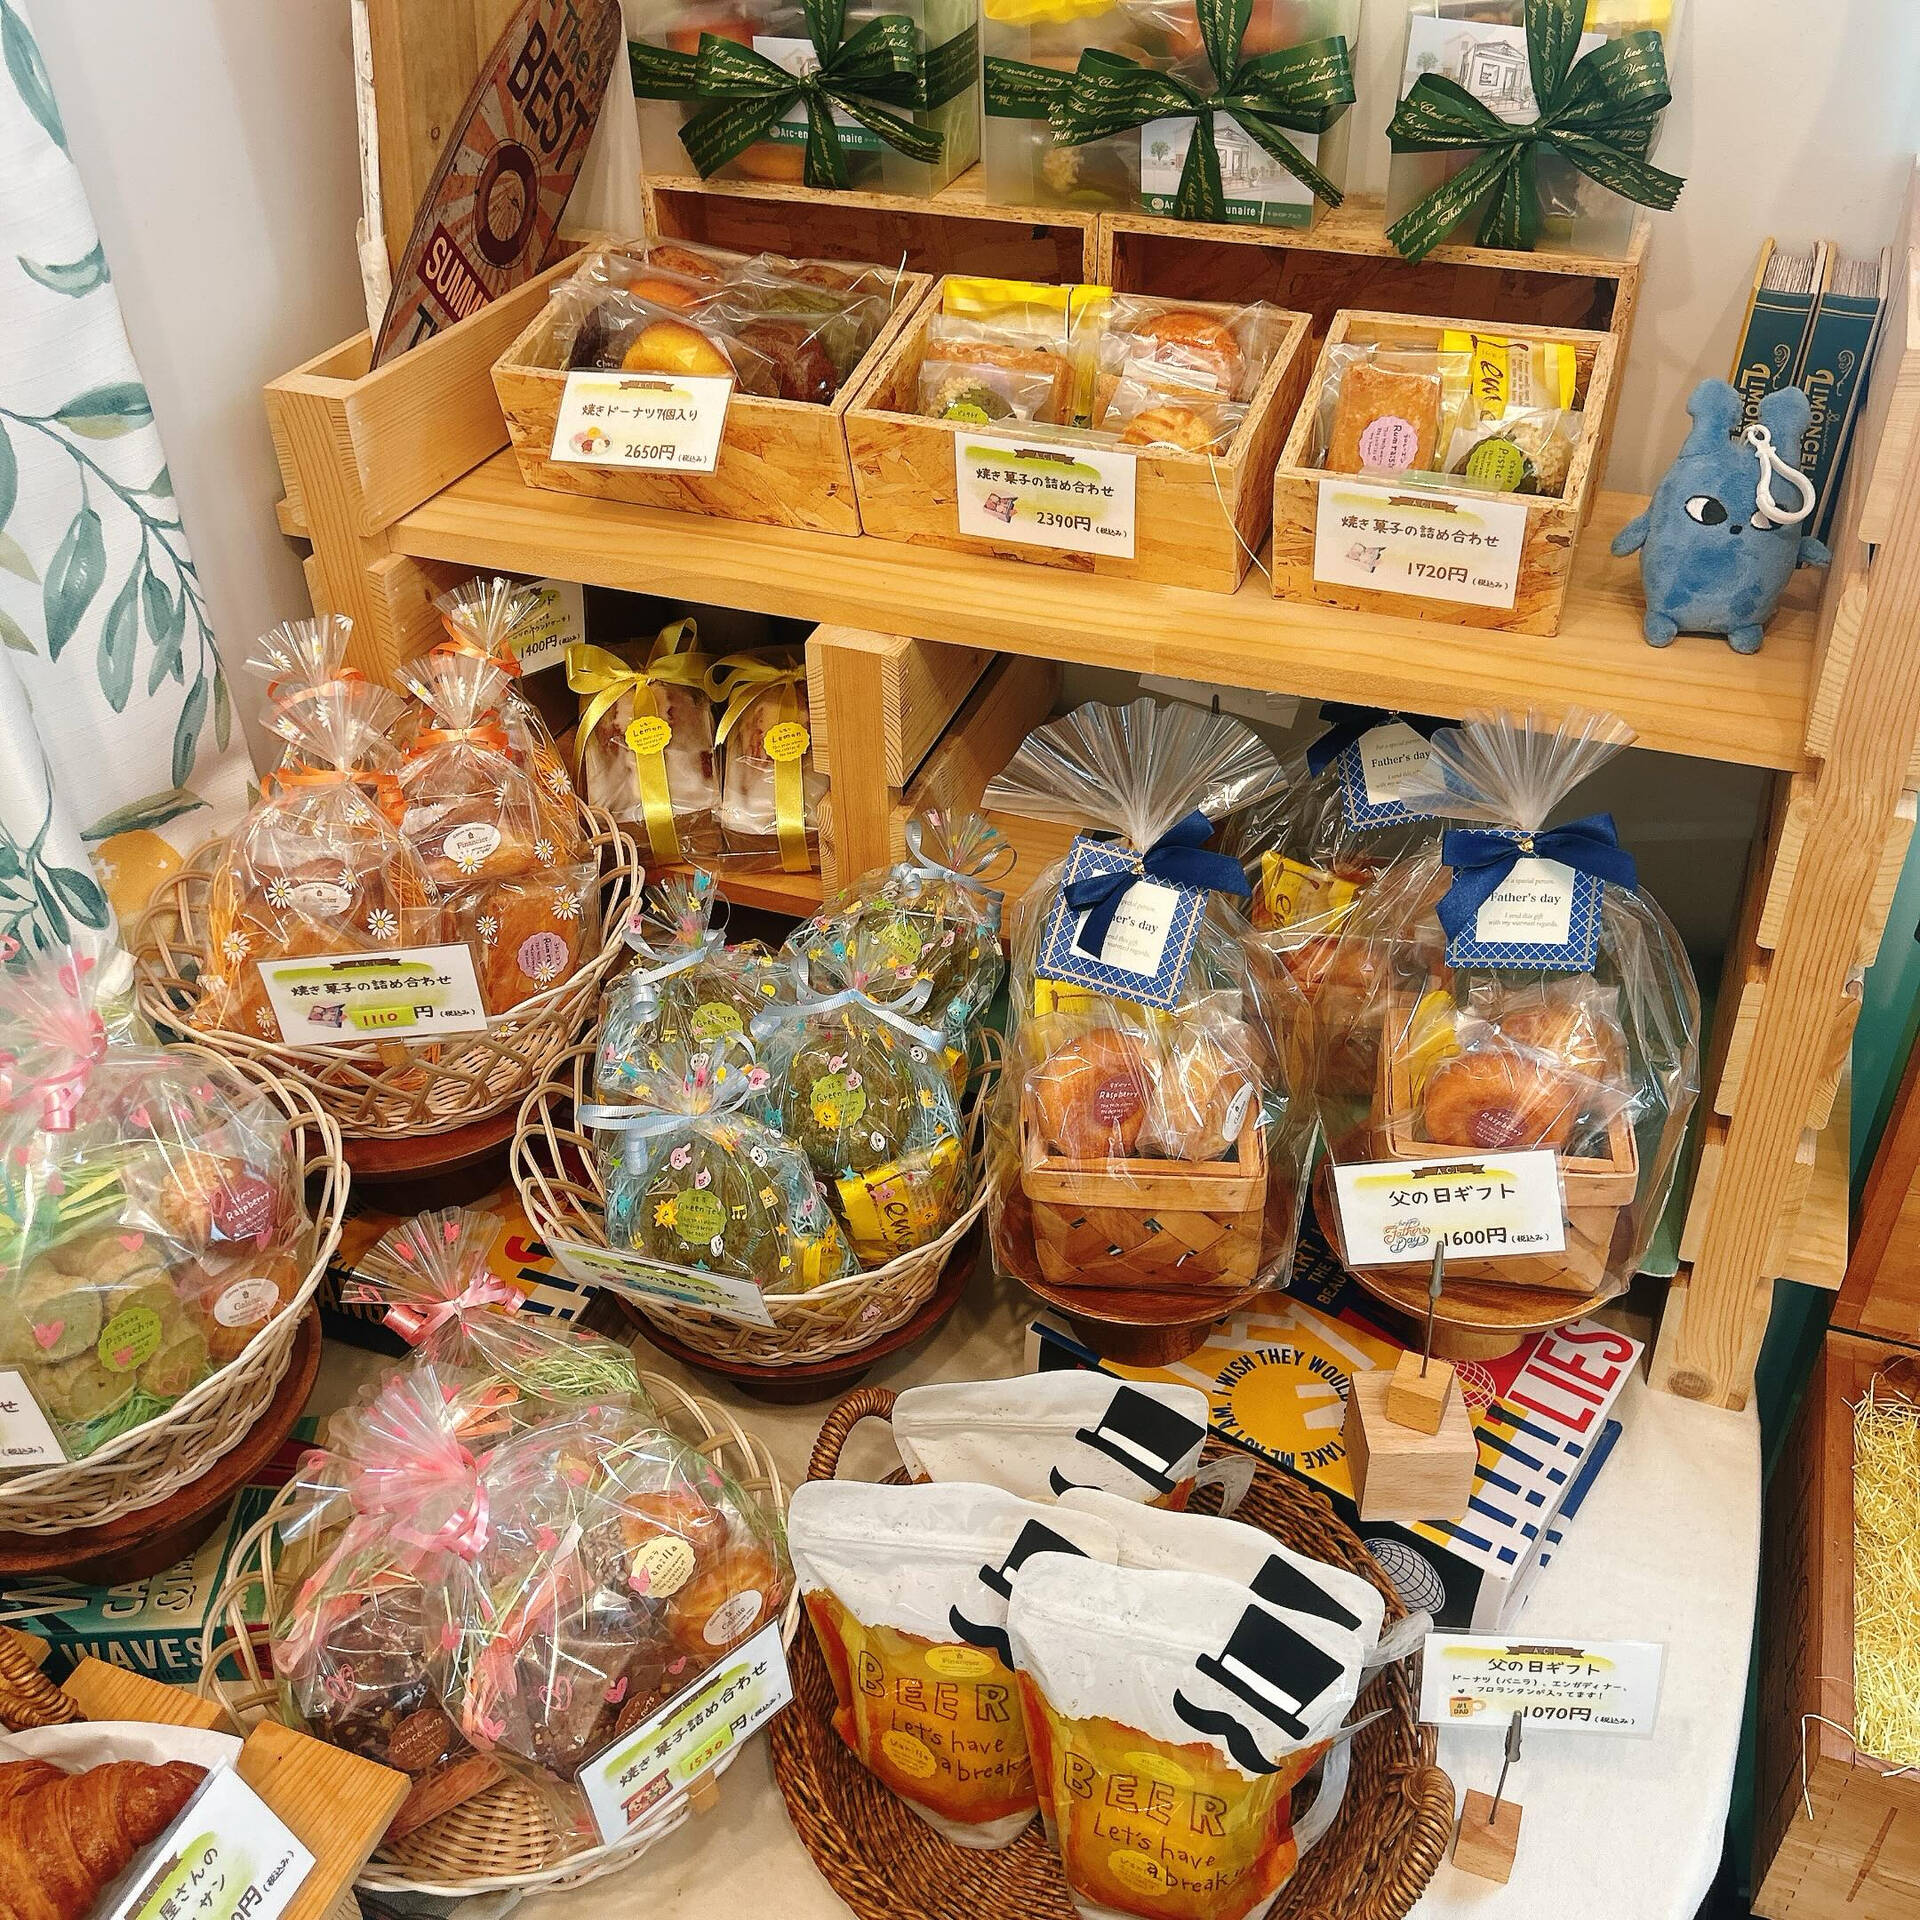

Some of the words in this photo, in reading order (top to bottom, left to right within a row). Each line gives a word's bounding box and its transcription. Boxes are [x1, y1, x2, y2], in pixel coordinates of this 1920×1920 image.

[556, 7, 590, 83] The
[507, 20, 592, 173] BEST
[582, 403, 698, 422] 焼きドーナツ7個入り
[624, 444, 676, 461] 2650円
[976, 467, 1115, 498] 焼き菓子の詰め合わせ
[1036, 511, 1092, 532] 2390円
[1341, 514, 1500, 548] 焼き菓子の詰め合わせ
[1407, 562, 1468, 584] 1720円
[520, 634, 558, 659] 1400円
[1371, 753, 1411, 768] Father's
[1413, 750, 1431, 761] day
[1490, 892, 1538, 903] Father's
[1540, 893, 1562, 906] day
[1139, 920, 1159, 935] day
[290, 975, 452, 997] 焼き菓子の詰め合わせ
[363, 1012, 398, 1027] 1110
[816, 1091, 842, 1103] Green
[1099, 1090, 1139, 1101] Raspberry
[226, 1191, 271, 1222] Raspberry
[1388, 1182, 1516, 1208] 父の日ギフト
[1442, 1227, 1507, 1248] 1600円
[105, 1320, 154, 1350] Pistachio
[1508, 1320, 1634, 1433] LIES
[1215, 1354, 1257, 1388] WISH
[1255, 1347, 1306, 1366] THEY
[1300, 1440, 1347, 1470] TAKE
[650, 1545, 679, 1578] anilla
[1488, 1658, 1601, 1676] 父の日ギフト
[858, 1650, 1010, 1723] BEER
[619, 1660, 768, 1788] 焼き菓子詰め合わせ
[1522, 1705, 1592, 1722] 1070円
[891, 1708, 943, 1746] Let's
[951, 1730, 1005, 1755] have
[688, 1739, 724, 1772] 1530
[941, 1756, 952, 1775] a
[1063, 1751, 1228, 1837] BEER
[1093, 1811, 1153, 1851] Let's
[1160, 1836, 1217, 1870] have
[1147, 1861, 1159, 1879] a
